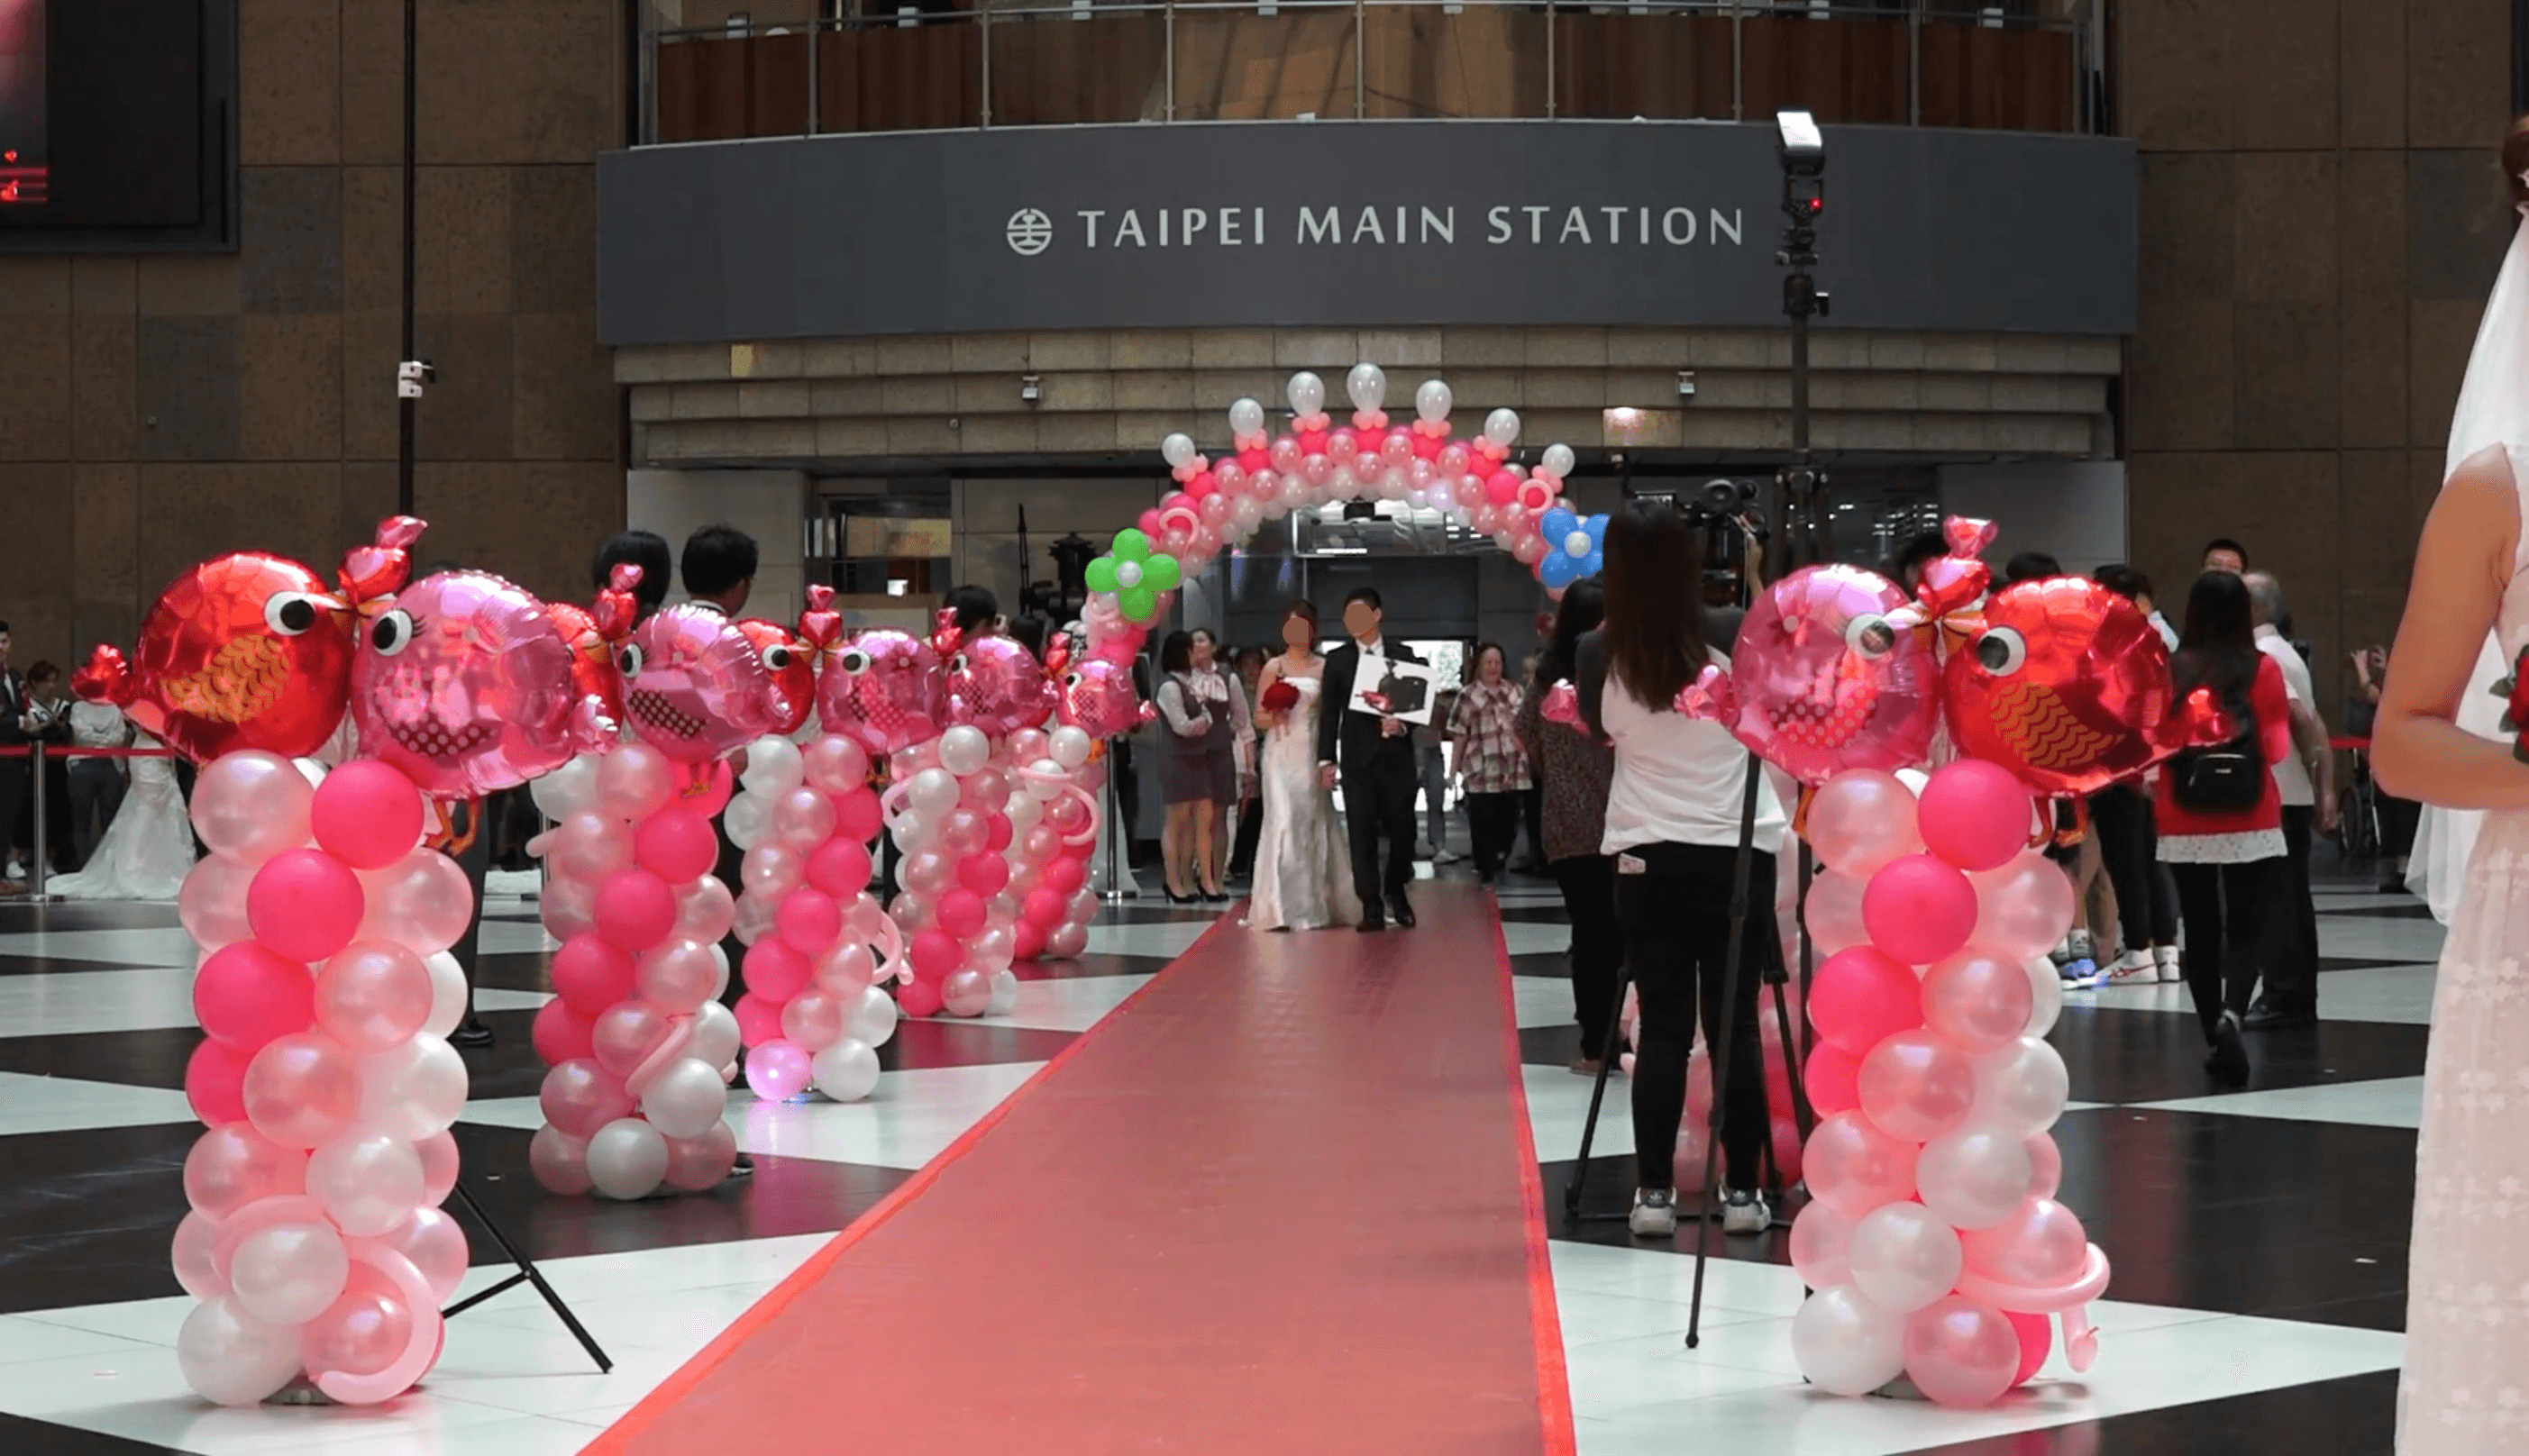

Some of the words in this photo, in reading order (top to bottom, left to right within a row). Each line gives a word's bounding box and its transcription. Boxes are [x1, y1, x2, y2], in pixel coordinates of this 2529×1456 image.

[1076, 207, 1264, 247] TAIPEI
[1296, 205, 1454, 244] MAIN
[1486, 205, 1744, 246] STATION
